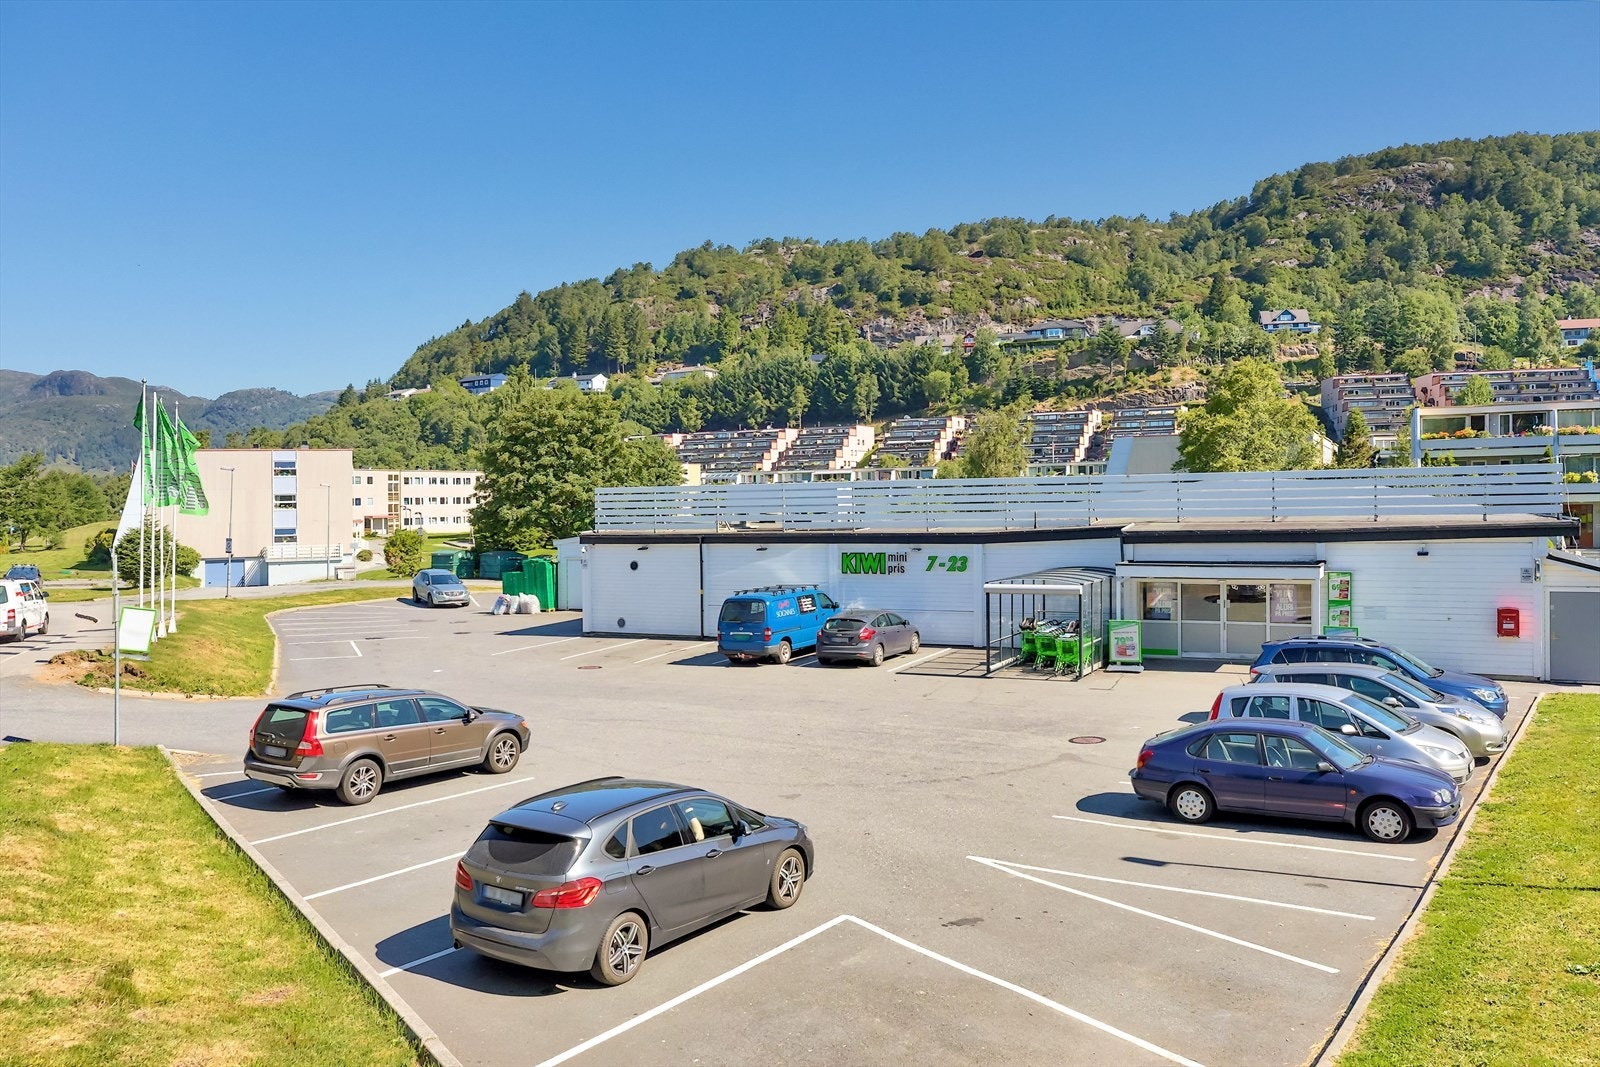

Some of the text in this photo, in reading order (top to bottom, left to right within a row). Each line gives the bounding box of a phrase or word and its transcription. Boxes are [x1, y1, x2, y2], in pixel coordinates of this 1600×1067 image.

[888, 552, 907, 562] mini
[841, 552, 886, 574] KIWI
[888, 564, 905, 575] pris
